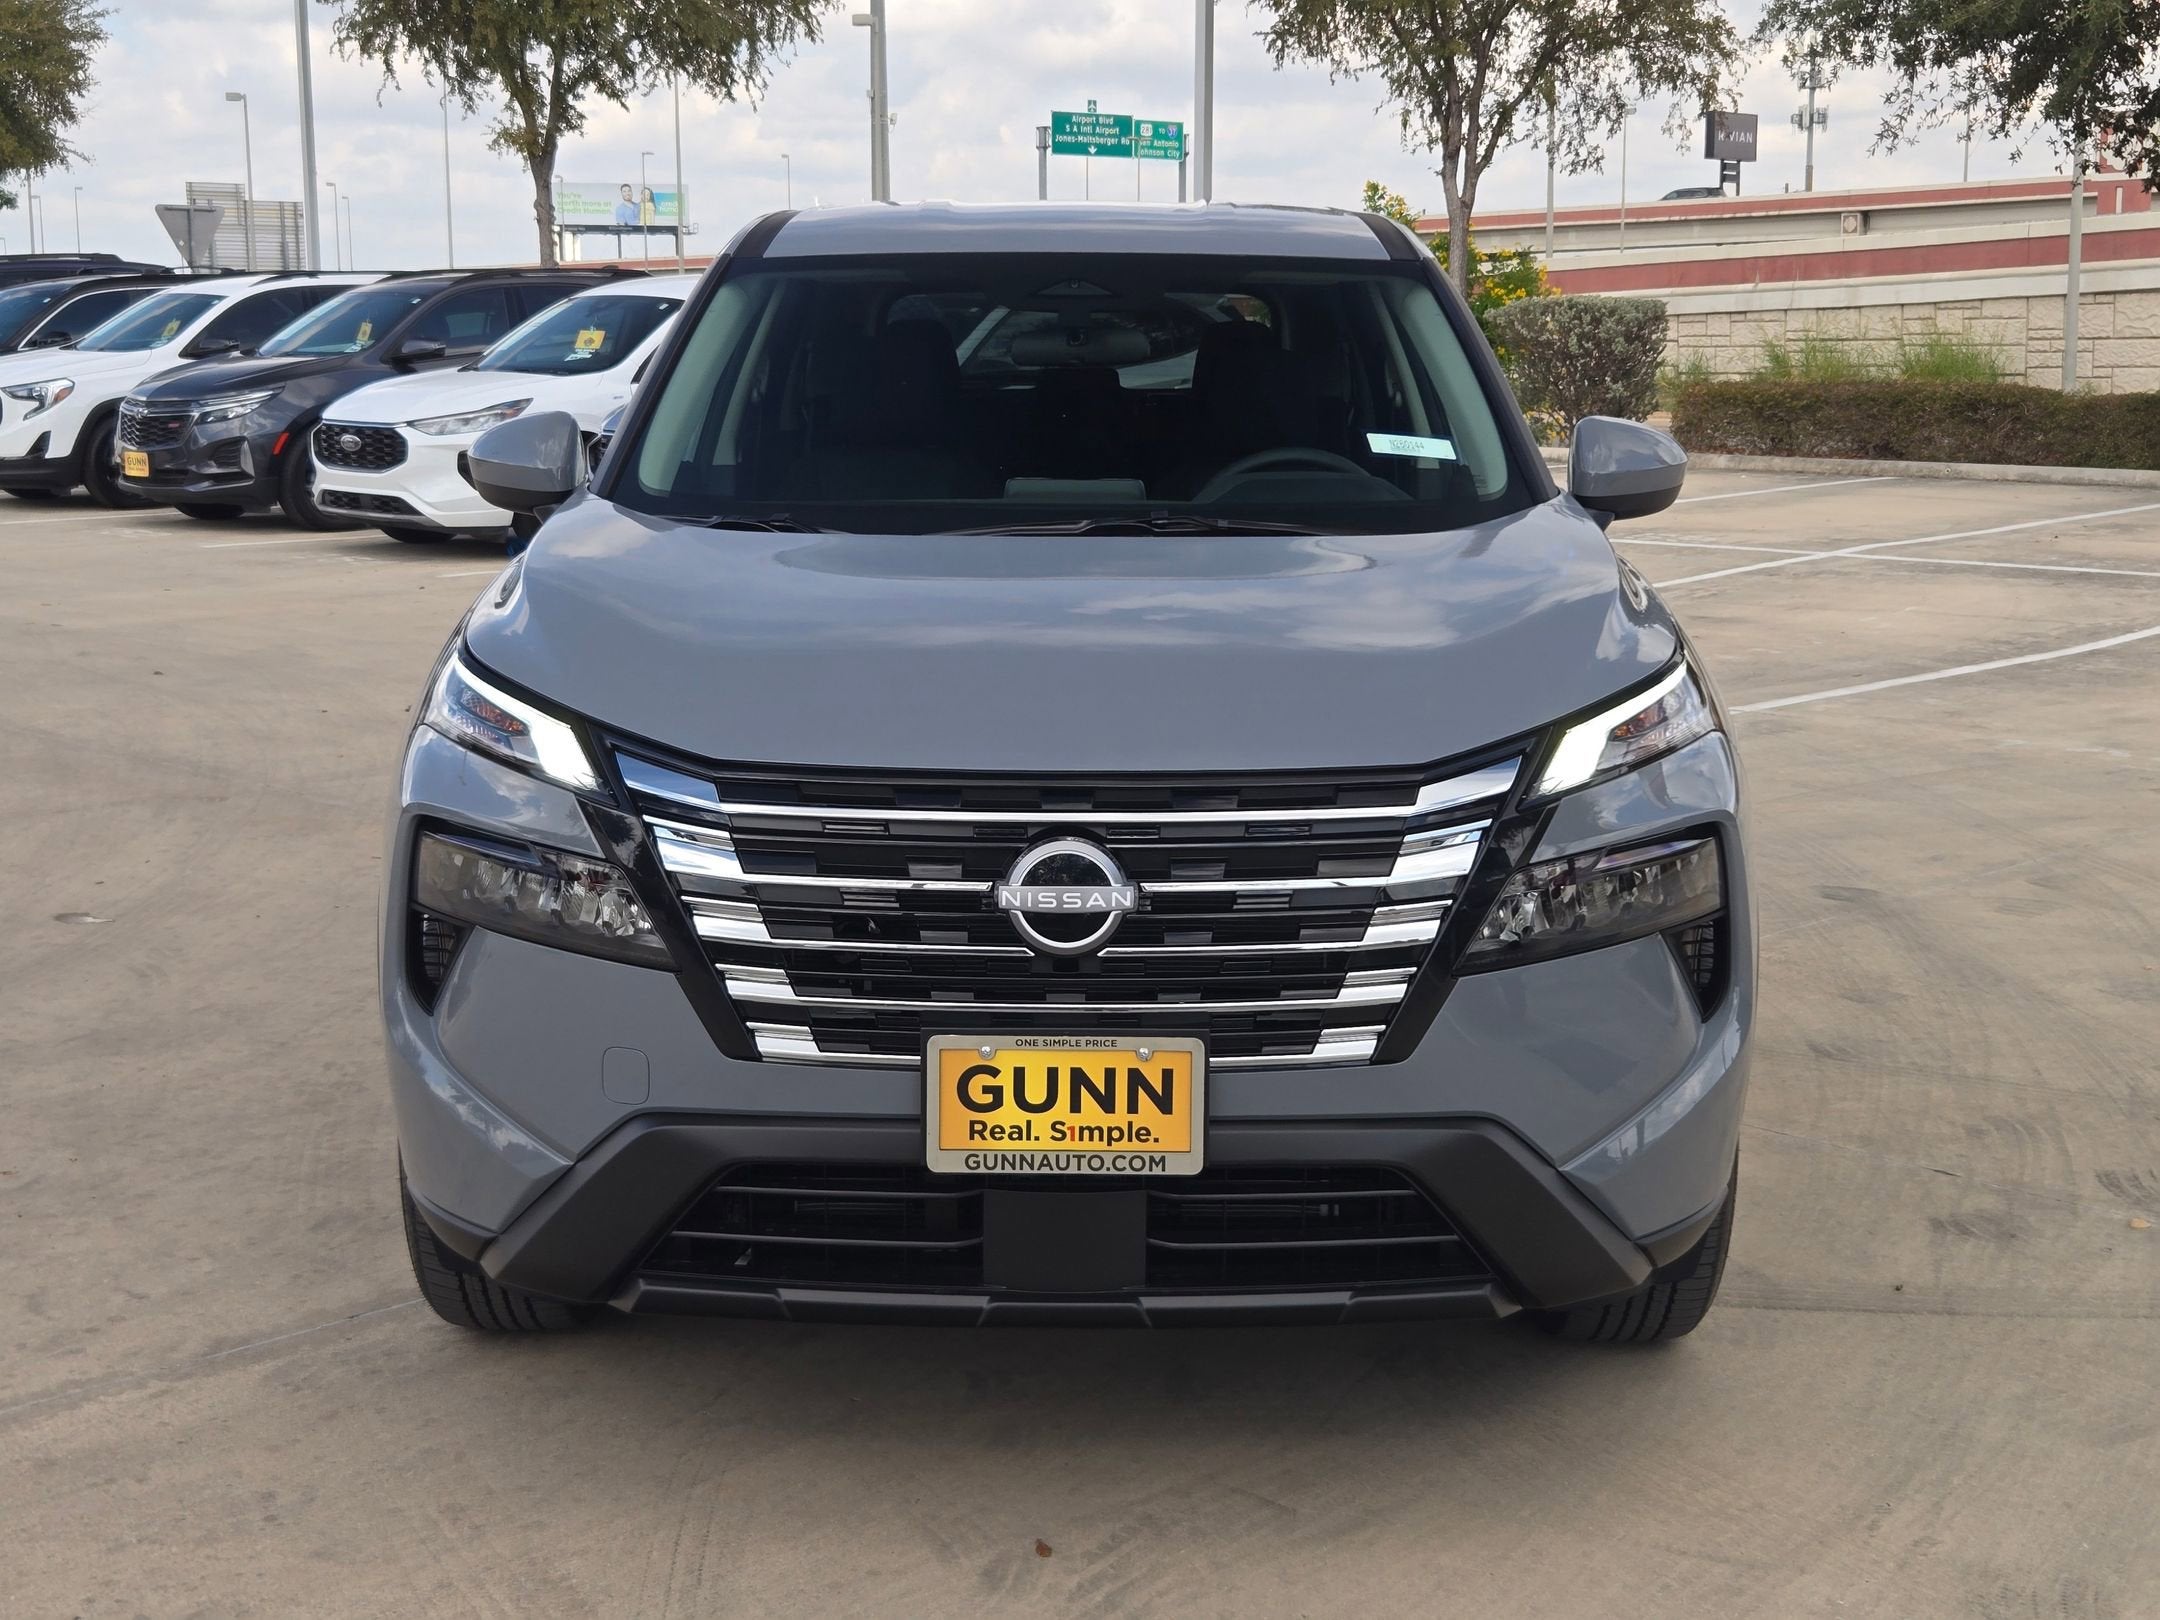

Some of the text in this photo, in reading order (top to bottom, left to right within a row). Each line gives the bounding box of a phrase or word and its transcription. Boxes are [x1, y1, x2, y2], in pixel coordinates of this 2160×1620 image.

[1071, 115, 1114, 125] Airport Blvd
[1065, 124, 1120, 136] S A Intl Airport
[1055, 134, 1119, 146] Jones-Maltsberger
[1718, 130, 1753, 143] RVIAN
[1153, 139, 1179, 149] Antonio
[1138, 148, 1180, 159] ohnson City
[127, 456, 147, 467] GUNN
[1001, 890, 1131, 909] NISSAN
[1015, 1038, 1118, 1048] ONE SIMPLE PRICE
[956, 1064, 1174, 1115] GUNN
[968, 1119, 1040, 1142] Real.
[964, 1153, 1166, 1173] GUNNAUTO.COM
